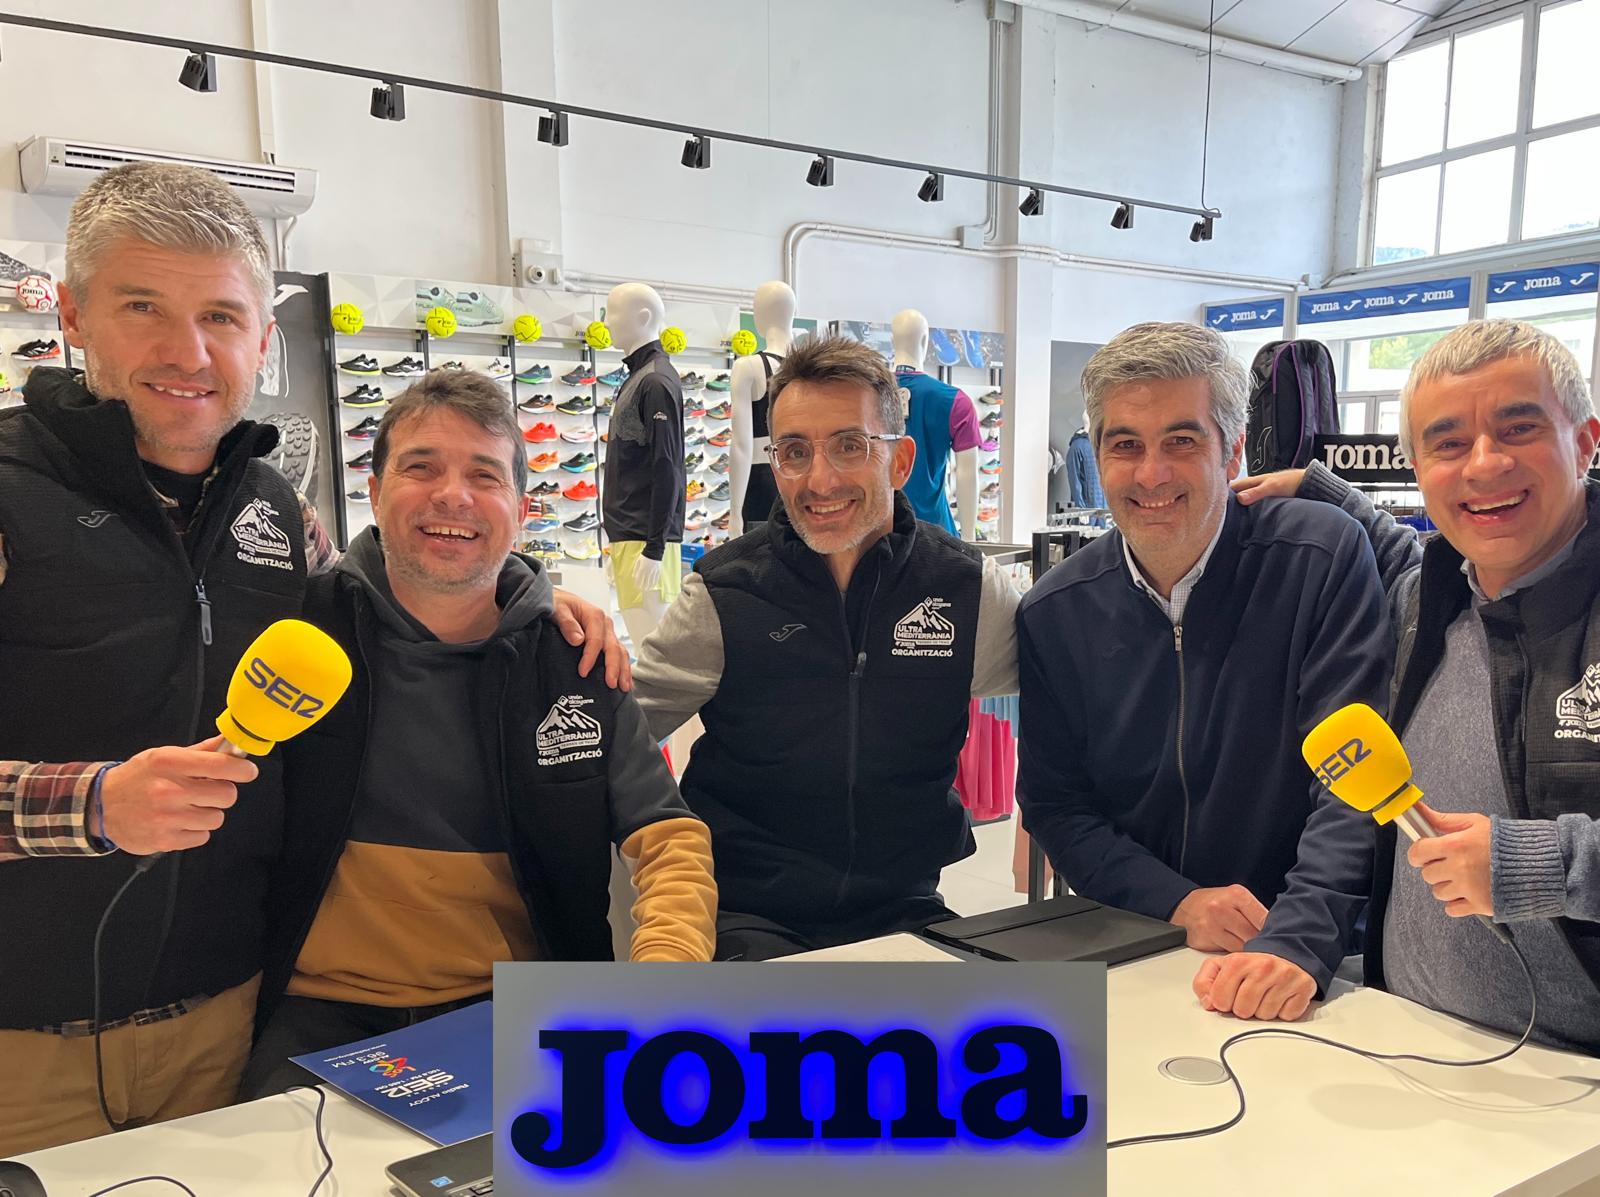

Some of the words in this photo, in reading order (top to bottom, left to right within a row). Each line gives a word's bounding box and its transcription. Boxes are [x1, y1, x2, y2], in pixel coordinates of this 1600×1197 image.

[1523, 276, 1562, 291] Joma
[1311, 302, 1340, 314] Joma
[1364, 295, 1395, 308] Joma
[1421, 290, 1454, 303] Joma
[1230, 310, 1257, 323] Joma
[237, 551, 294, 571] ORGANITZACIÓ
[898, 624, 923, 633] ULTRA
[891, 648, 953, 657] ORGANITZACIÓ
[243, 657, 324, 719] SER
[539, 729, 565, 741] ULTRA
[537, 747, 603, 766] ORGANITZACIÓ
[331, 1059, 356, 1068] FM
[380, 1071, 454, 1098] SER
[409, 1093, 441, 1107] ALCOY
